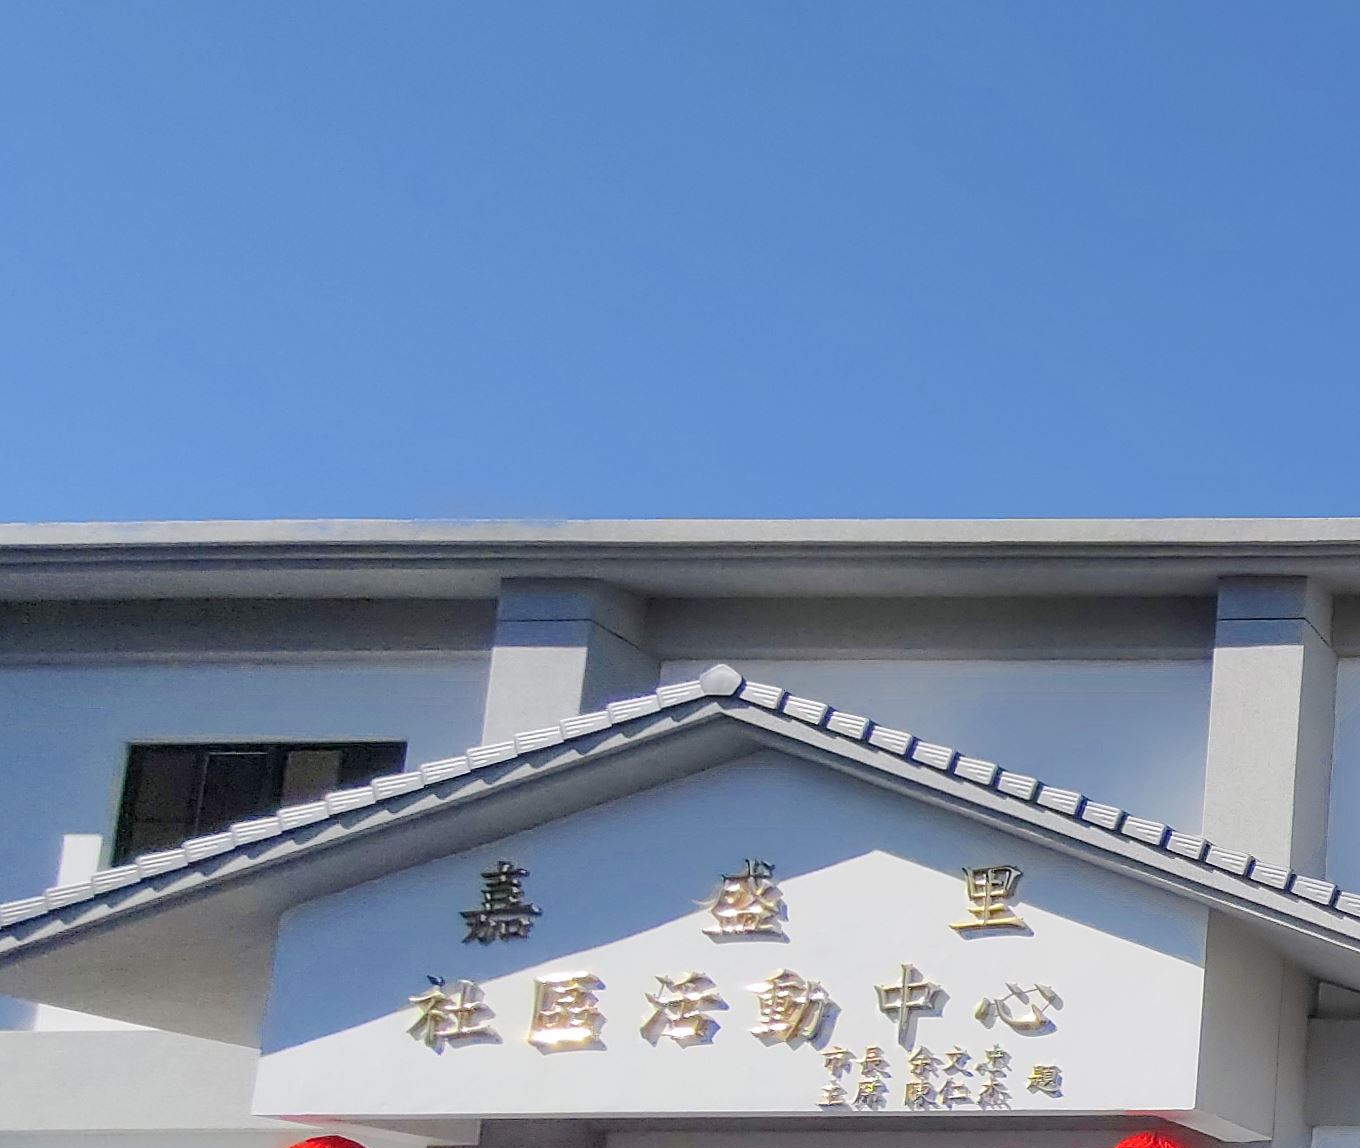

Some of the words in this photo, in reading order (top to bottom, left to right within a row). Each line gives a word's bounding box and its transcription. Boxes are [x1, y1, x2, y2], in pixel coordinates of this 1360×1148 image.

[459, 859, 1029, 943] 嘉盛里
[407, 964, 1062, 1052] 社區活動中心
[820, 1045, 892, 1078] 市長
[816, 1079, 890, 1110] 主席
[1026, 1064, 1065, 1098] 題
